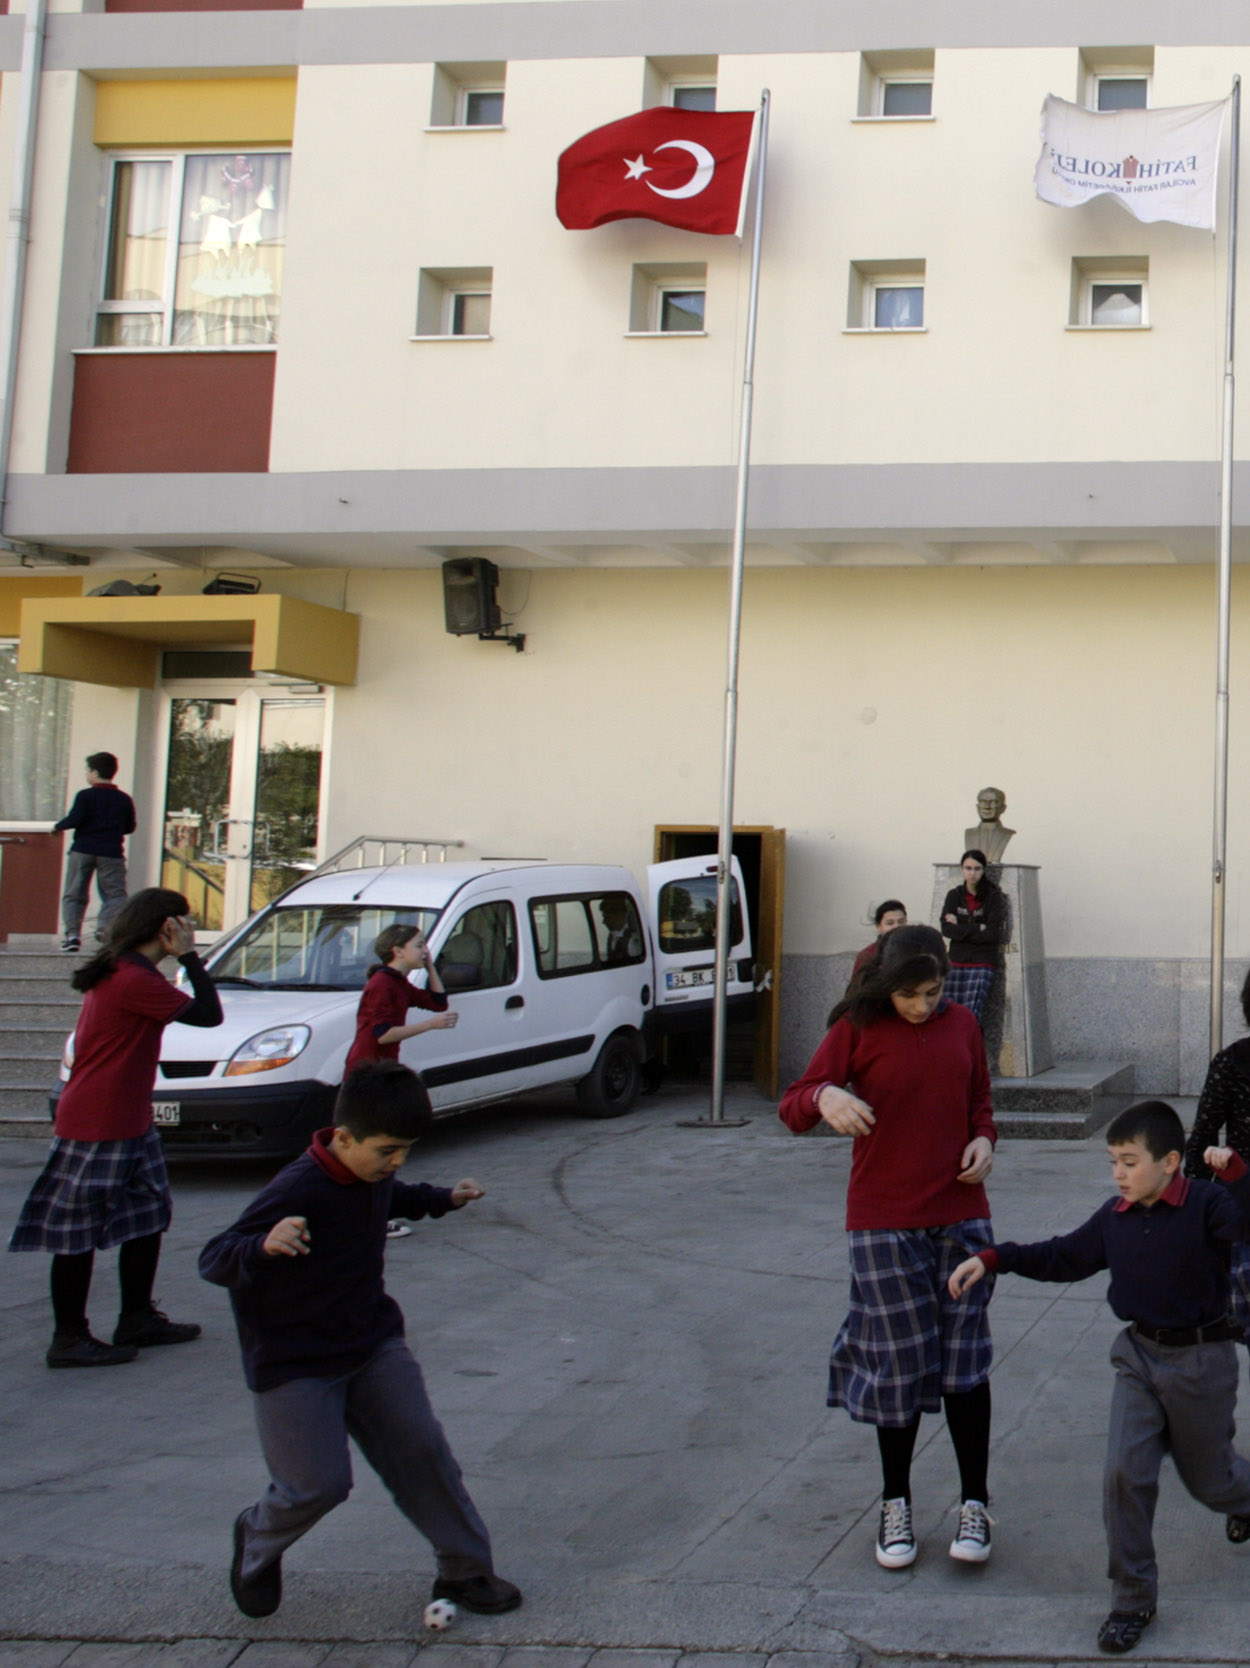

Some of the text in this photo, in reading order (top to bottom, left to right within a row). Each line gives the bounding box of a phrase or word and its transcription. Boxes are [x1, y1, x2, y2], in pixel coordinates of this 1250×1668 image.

[673, 974, 686, 986] 34
[692, 972, 704, 983] BK
[151, 1105, 178, 1121] 401
